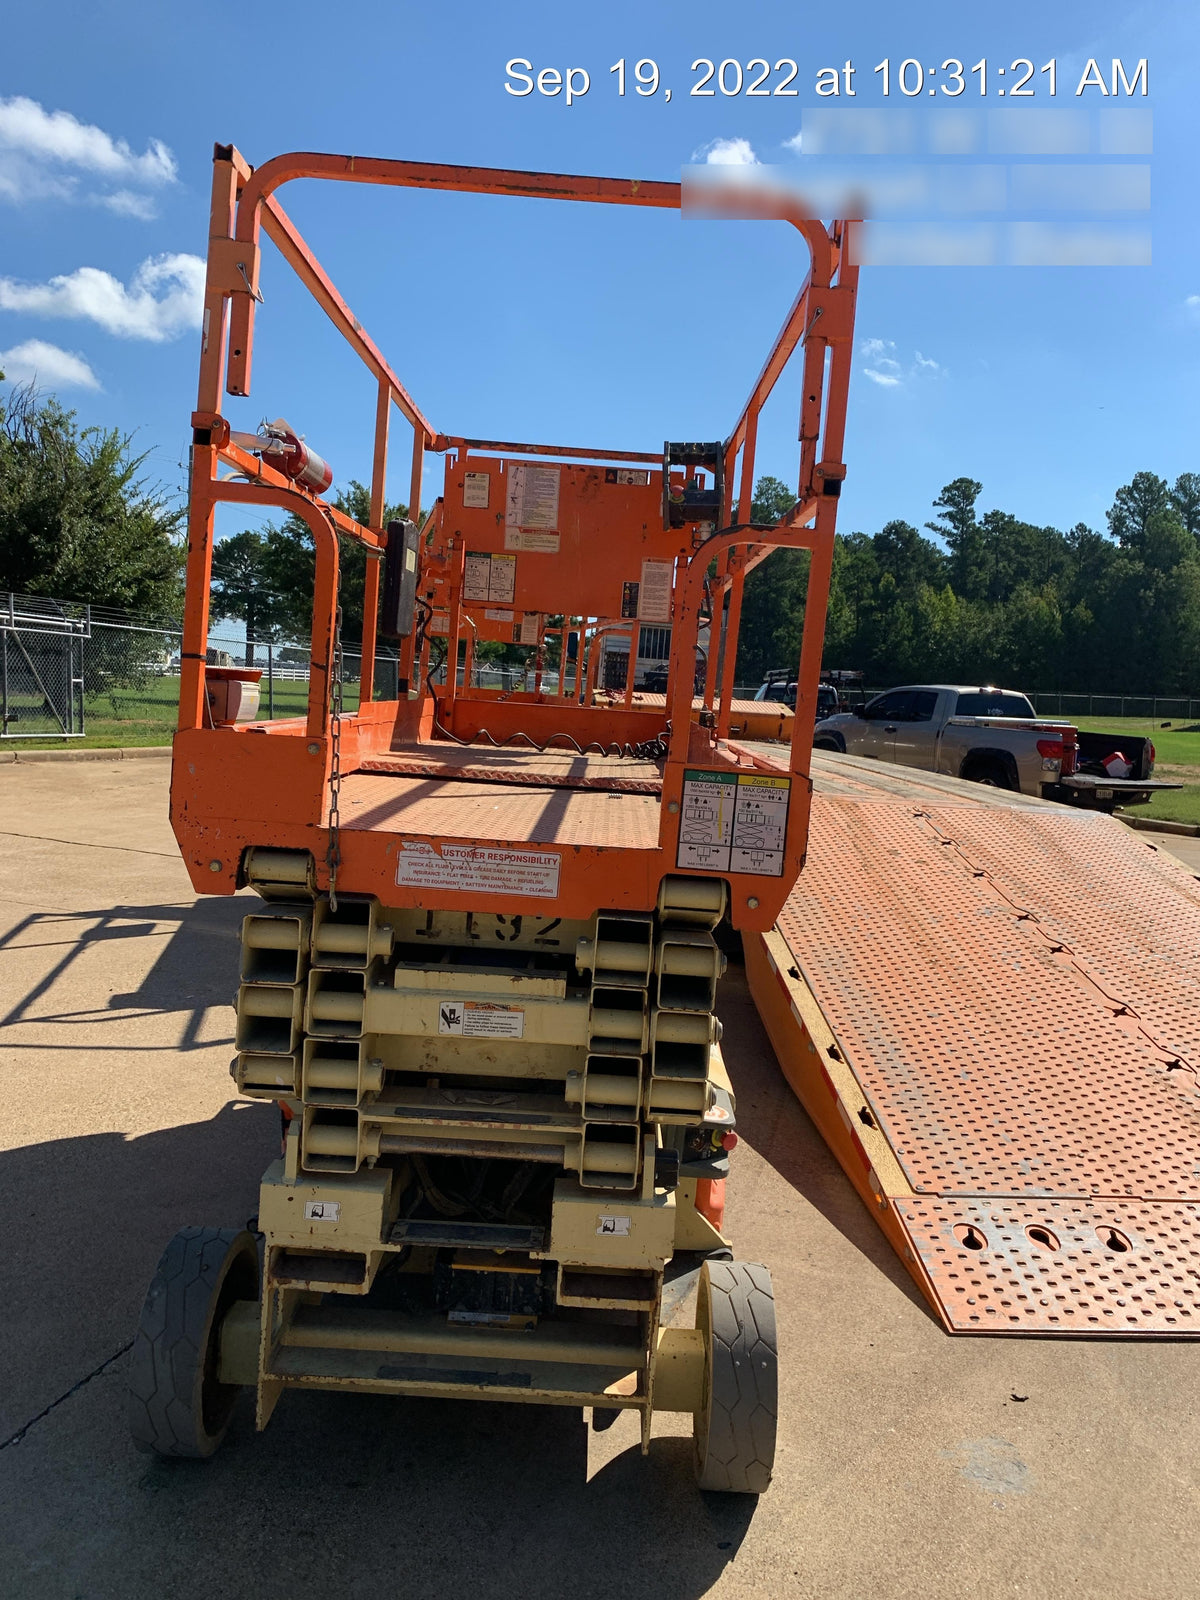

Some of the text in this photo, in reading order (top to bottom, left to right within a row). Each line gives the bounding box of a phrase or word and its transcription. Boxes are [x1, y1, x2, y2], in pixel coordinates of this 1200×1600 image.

[698, 773, 715, 781] Zone
[756, 788, 785, 796] CAPACITY
[443, 849, 558, 865] USTOMER RESPONSIBILITY
